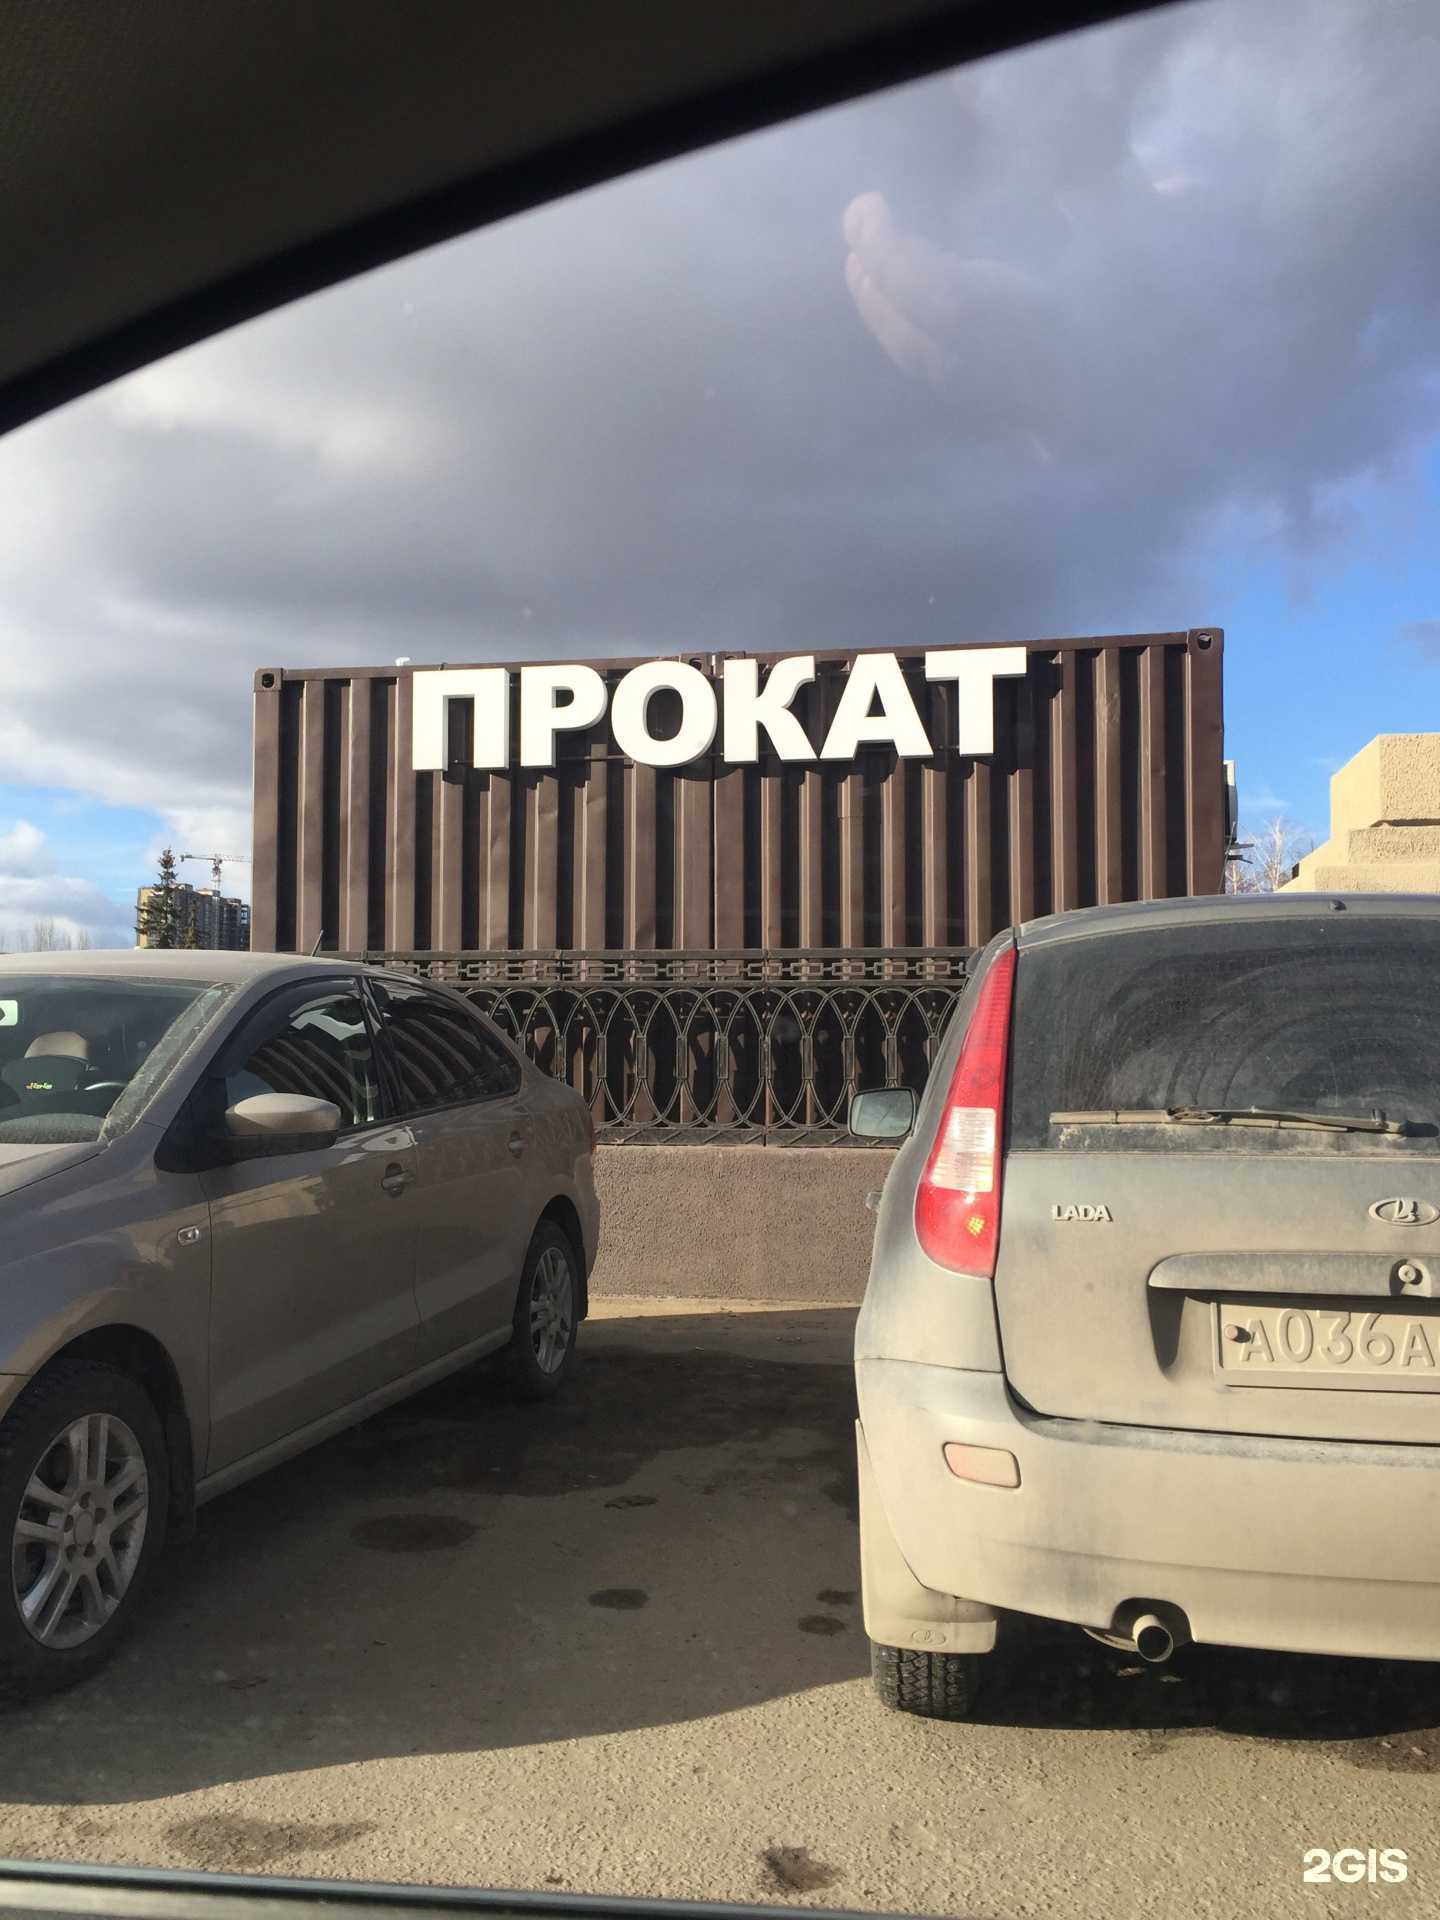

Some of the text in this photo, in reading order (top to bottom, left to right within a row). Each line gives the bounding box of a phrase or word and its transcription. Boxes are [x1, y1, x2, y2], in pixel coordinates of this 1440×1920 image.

[412, 646, 1027, 771] ПРОКАТ
[1051, 1204, 1113, 1222] LADA
[1240, 1308, 1440, 1367] А036А
